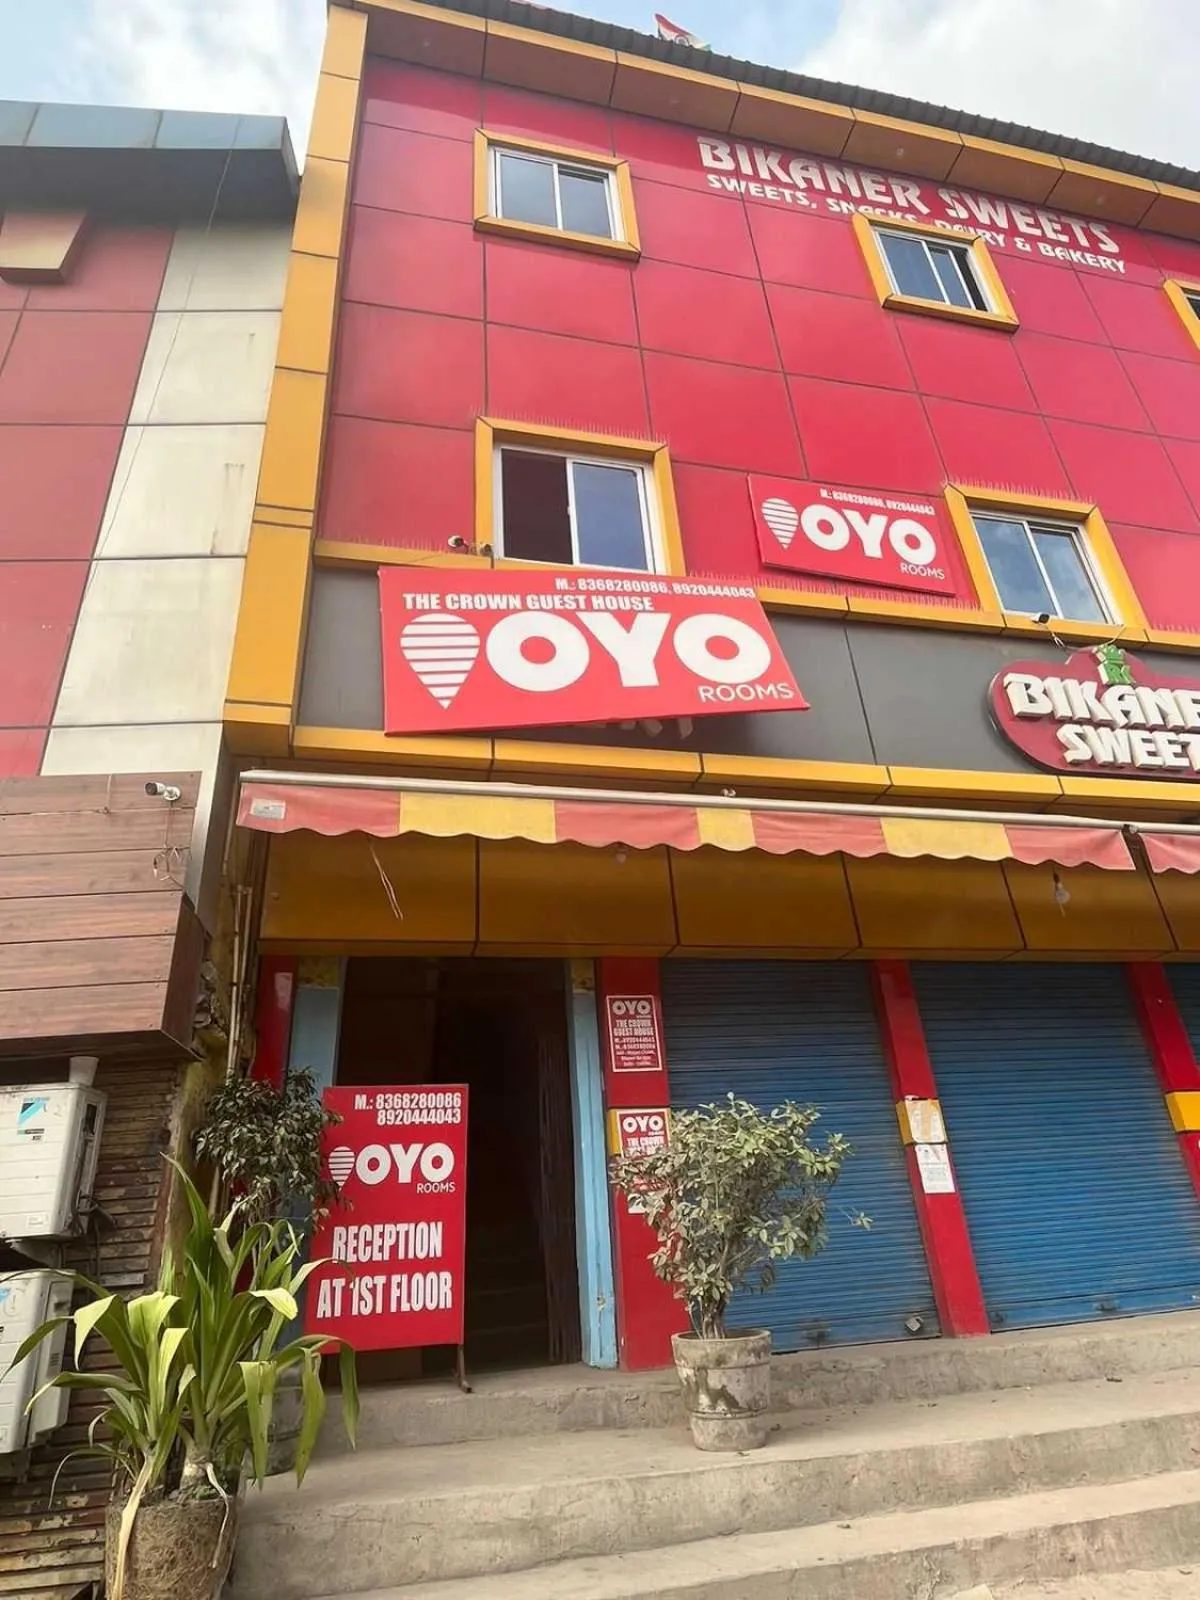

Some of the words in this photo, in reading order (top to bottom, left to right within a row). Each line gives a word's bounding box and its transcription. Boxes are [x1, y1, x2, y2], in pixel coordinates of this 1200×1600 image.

[697, 136, 931, 215] BIKANER
[937, 188, 1120, 253] SWEETS
[1013, 237, 1032, 252] &
[1036, 242, 1126, 273] BAKERY
[800, 504, 937, 565] OYO
[900, 562, 945, 580] ROOMS
[672, 582, 755, 598] 8920444043
[402, 593, 441, 609] THE
[445, 593, 522, 610] CROWN
[526, 594, 587, 611] GUEST
[591, 595, 655, 611] HOUSE
[485, 611, 772, 692] OYO
[699, 683, 795, 702] ROOMS
[612, 1000, 651, 1015] OYO
[354, 1094, 373, 1110] M.:
[375, 1092, 462, 1110] 8368280086
[377, 1108, 461, 1126] 8920444043
[622, 1115, 664, 1133] OYO
[355, 1142, 455, 1185] OYO
[416, 1182, 456, 1194] ROOMS
[332, 1222, 443, 1263] RECEPTION
[316, 1278, 346, 1319] AT
[351, 1276, 387, 1316] 1ST
[390, 1271, 452, 1313] FLOOR
